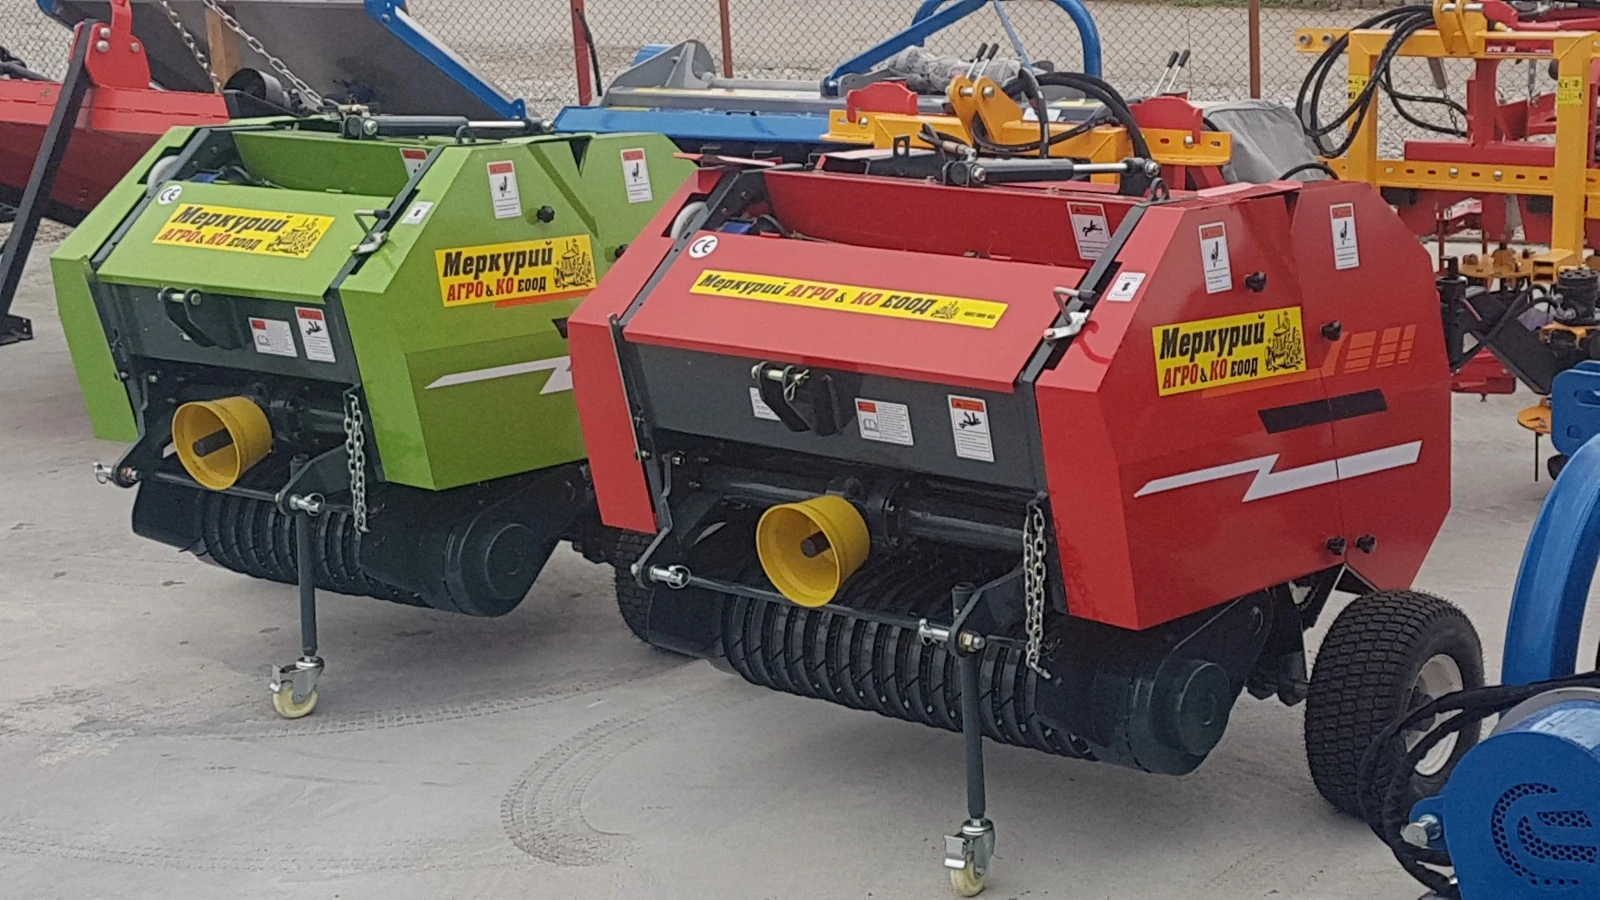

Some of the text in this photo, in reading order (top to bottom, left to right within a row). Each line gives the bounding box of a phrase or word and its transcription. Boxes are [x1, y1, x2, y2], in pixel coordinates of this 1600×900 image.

[160, 188, 181, 202] CE
[171, 206, 293, 234] Меркурий
[158, 228, 263, 251] АГРО & КО ЕООД
[692, 239, 716, 253] CE
[443, 240, 554, 280] Меркурий
[446, 276, 547, 302] АГРО & КО ЕООД
[697, 274, 938, 315] Меркурий АГРО & КО ЕООД
[1159, 313, 1266, 363] Меркурий
[1162, 357, 1258, 389] АГРО & КО ЕООД
